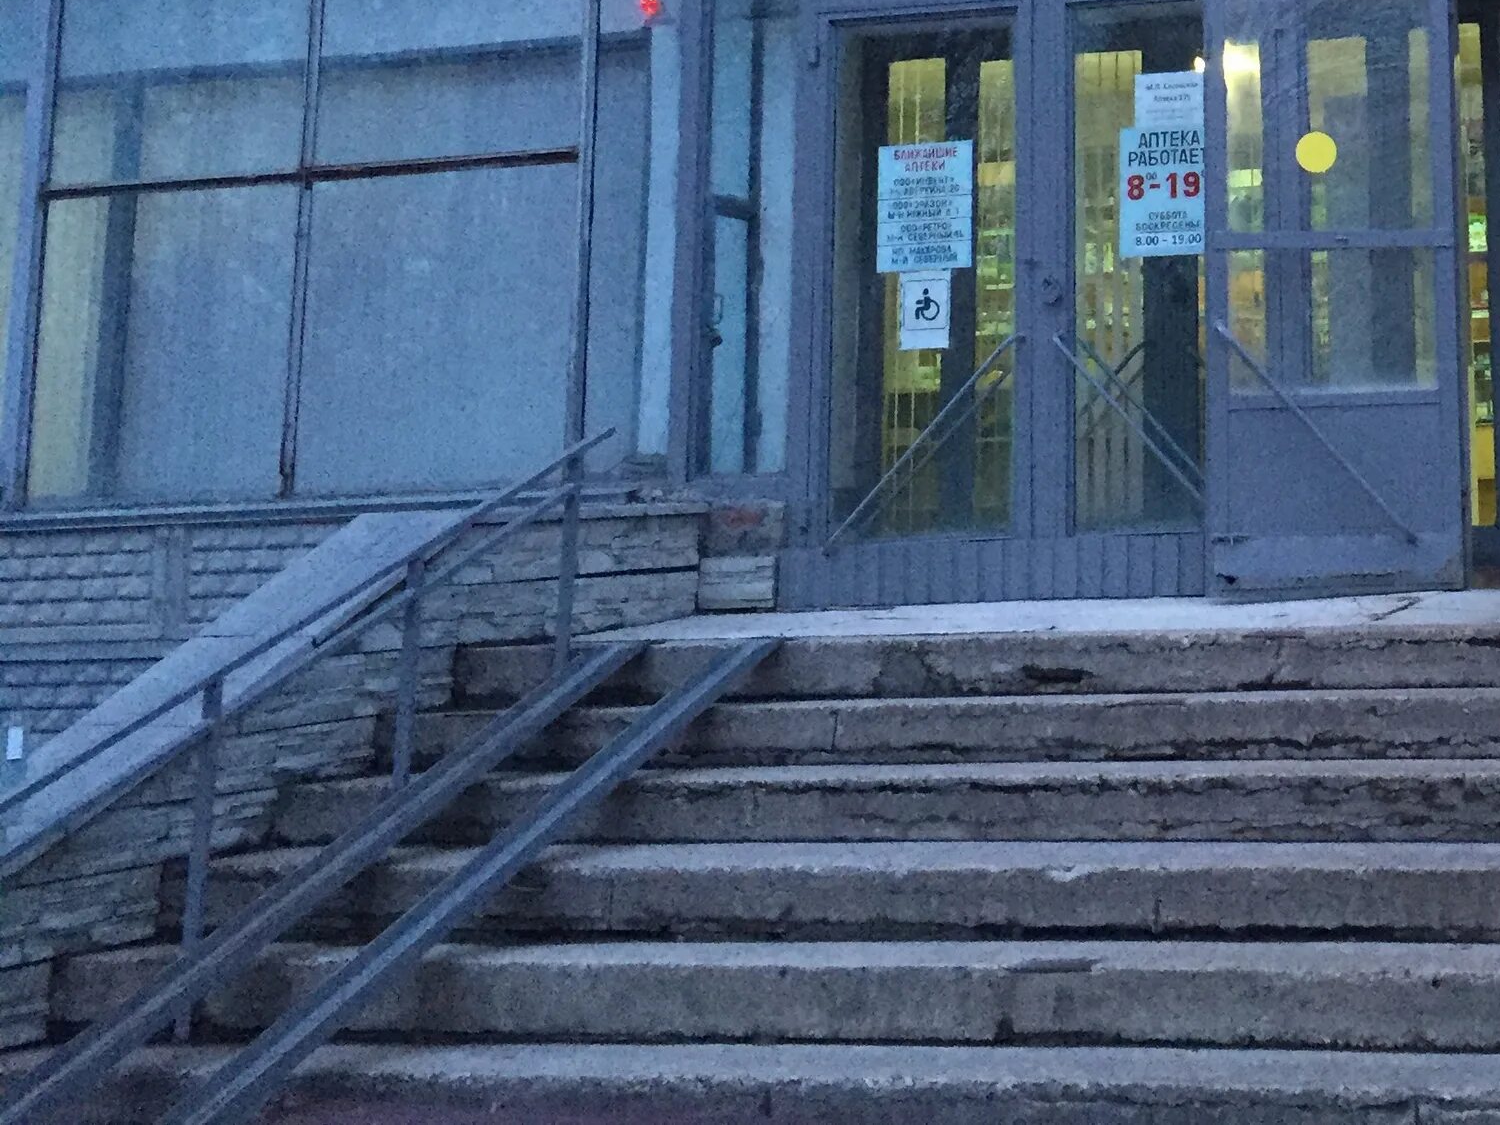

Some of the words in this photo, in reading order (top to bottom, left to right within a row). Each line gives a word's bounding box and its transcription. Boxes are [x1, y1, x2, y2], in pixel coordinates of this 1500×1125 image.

[1138, 130, 1201, 149] АПТЕКА
[893, 146, 958, 160] БЛИЖАЙШИЕ
[1135, 235, 1159, 246] 8.00
[1171, 233, 1202, 245] 19.00
